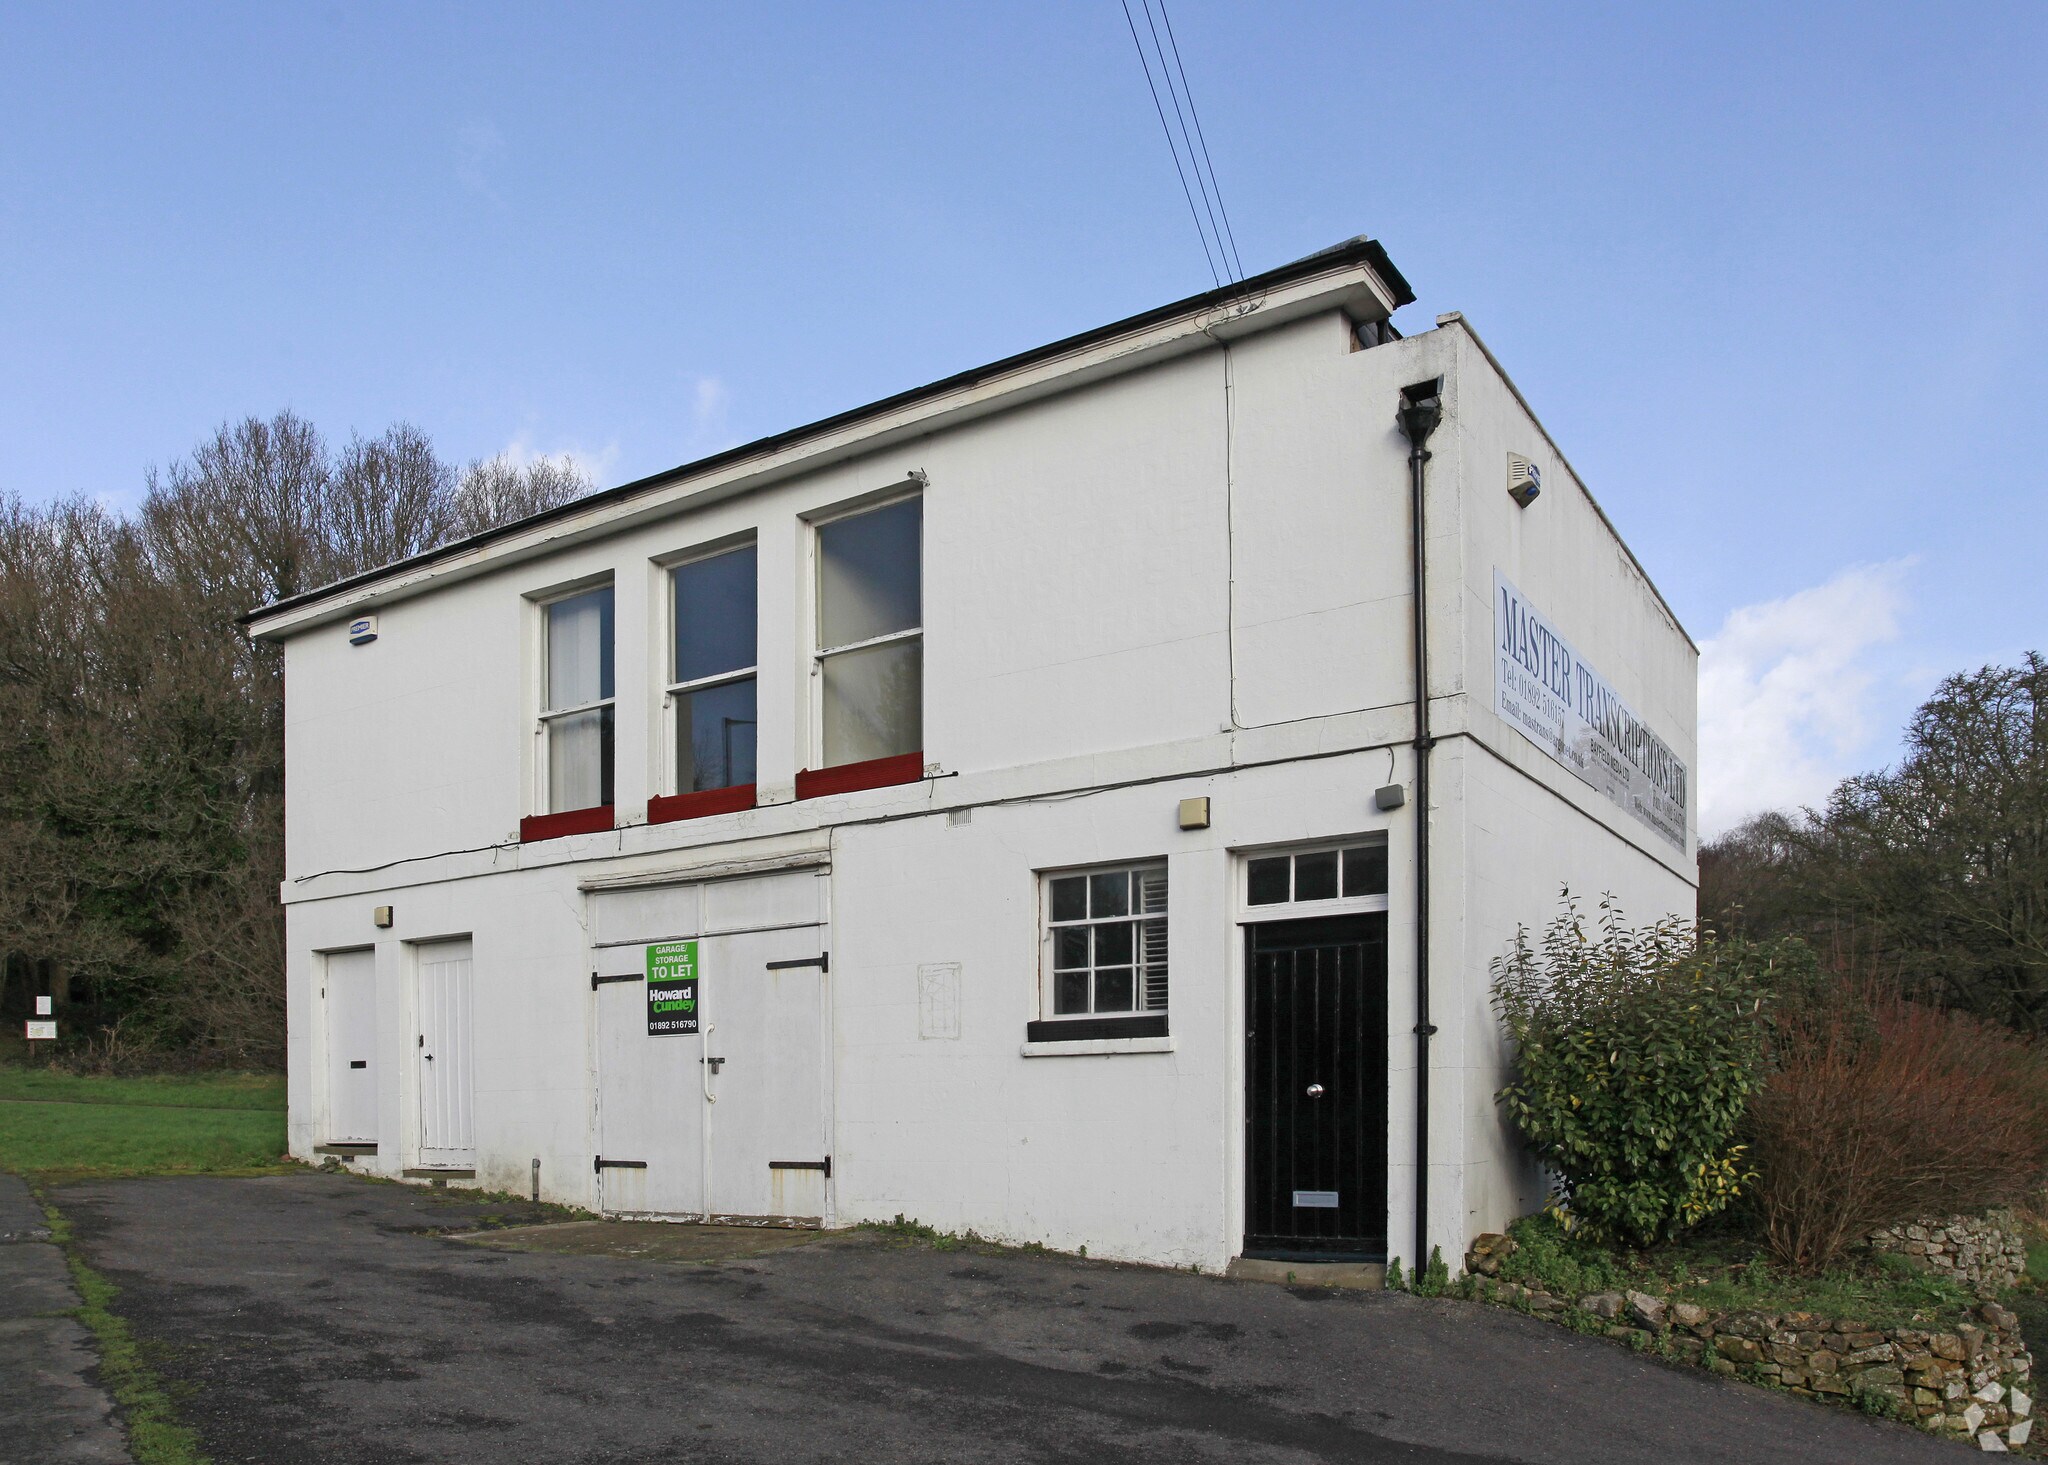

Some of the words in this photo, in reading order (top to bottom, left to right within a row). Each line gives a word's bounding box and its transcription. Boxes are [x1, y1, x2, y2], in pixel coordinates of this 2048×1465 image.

[1501, 658, 1516, 692] Tel:
[1519, 674, 1540, 710] 01892
[1501, 586, 1571, 708] MASTER
[1576, 661, 1668, 794] TRANSCRIPTIONS
[1669, 757, 1685, 809] LTD
[1501, 691, 1521, 721] Email:
[656, 944, 688, 954] GARAGE/
[655, 955, 689, 965] STORAGE
[652, 966, 667, 978] TO
[671, 964, 692, 977] LET
[650, 987, 692, 1001] Howard
[653, 1000, 695, 1013] Cundey
[650, 1021, 670, 1030] 01892
[671, 1020, 697, 1029] 516790
